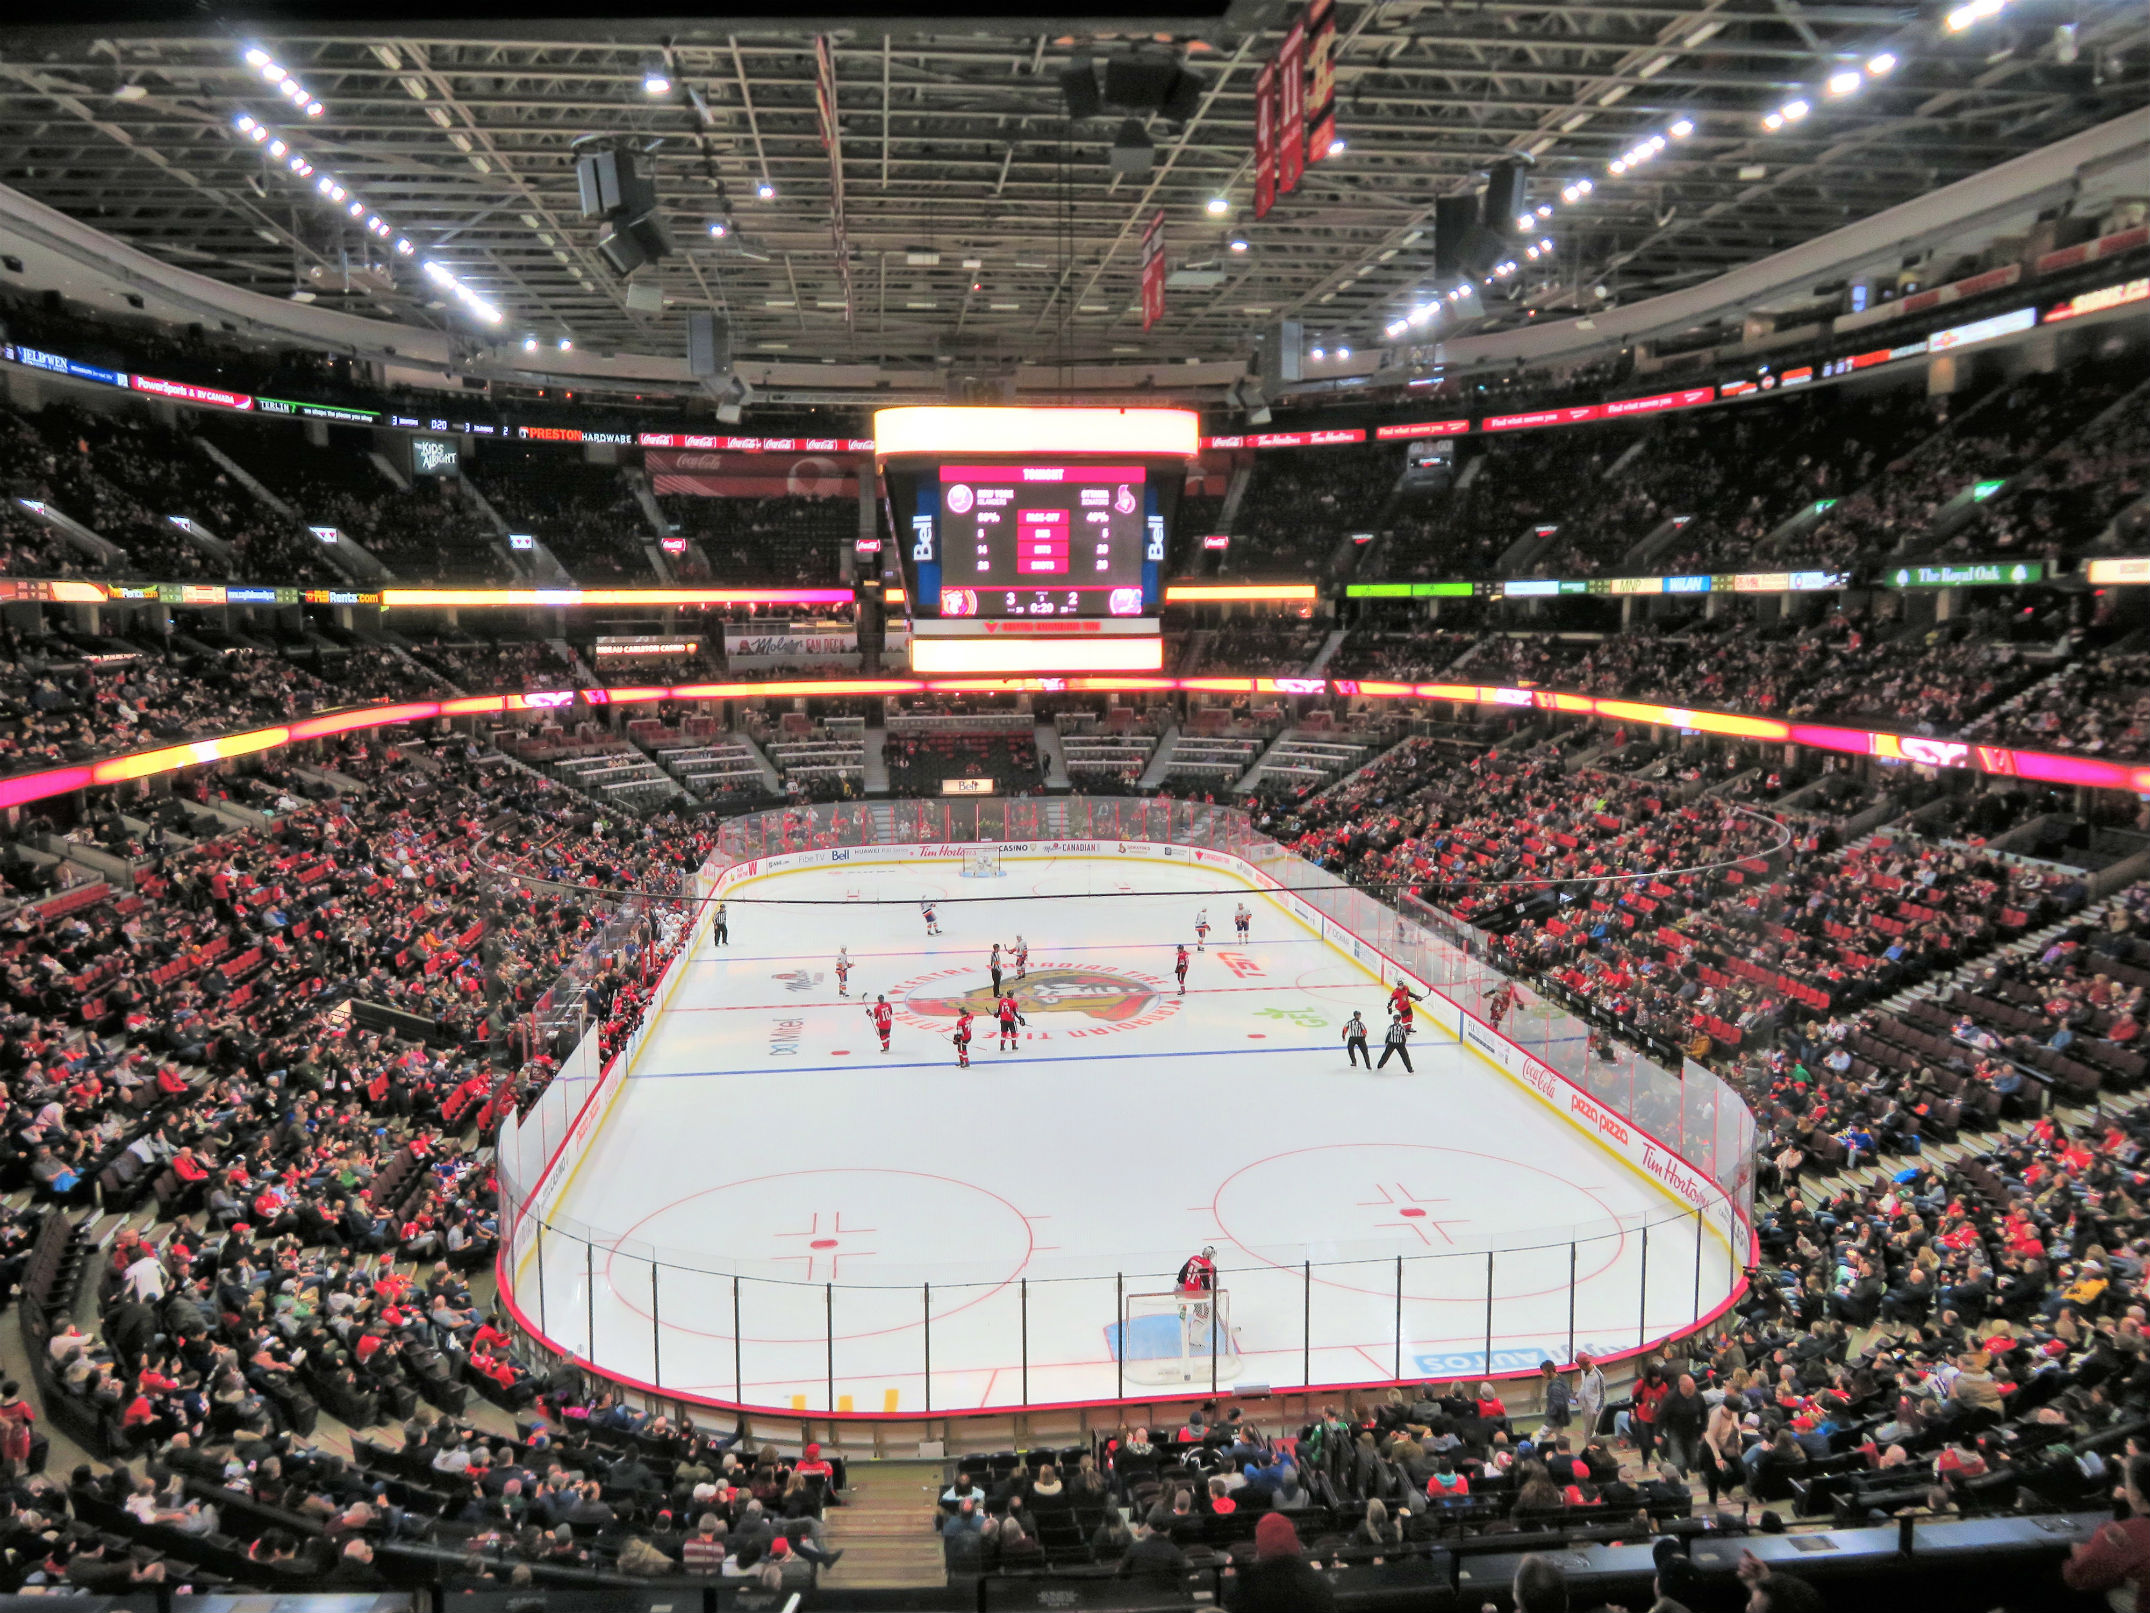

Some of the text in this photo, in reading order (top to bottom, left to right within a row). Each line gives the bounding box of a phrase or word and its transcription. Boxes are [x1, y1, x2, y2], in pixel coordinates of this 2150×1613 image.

[529, 427, 632, 444] PRESTON HARDWARE
[1311, 430, 1355, 444] Tim Hortons
[913, 515, 932, 560] Bell
[1148, 515, 1163, 560] Bell
[1919, 565, 2000, 585] The Royal Oak
[1006, 592, 1078, 605] 3 2
[1030, 602, 1054, 613] 0:20
[660, 644, 686, 652] CASINO
[919, 845, 938, 858] Tim
[939, 844, 977, 858] Hortons
[999, 844, 1029, 852] CASINO
[1062, 843, 1096, 852] CANADIAN
[832, 849, 850, 861] Bell
[1121, 970, 1169, 985] TIRE
[1571, 1094, 1629, 1146] pizza pizza
[1642, 1142, 1710, 1213] Tim Hortons
[1423, 1351, 1539, 1373] AUTOS
